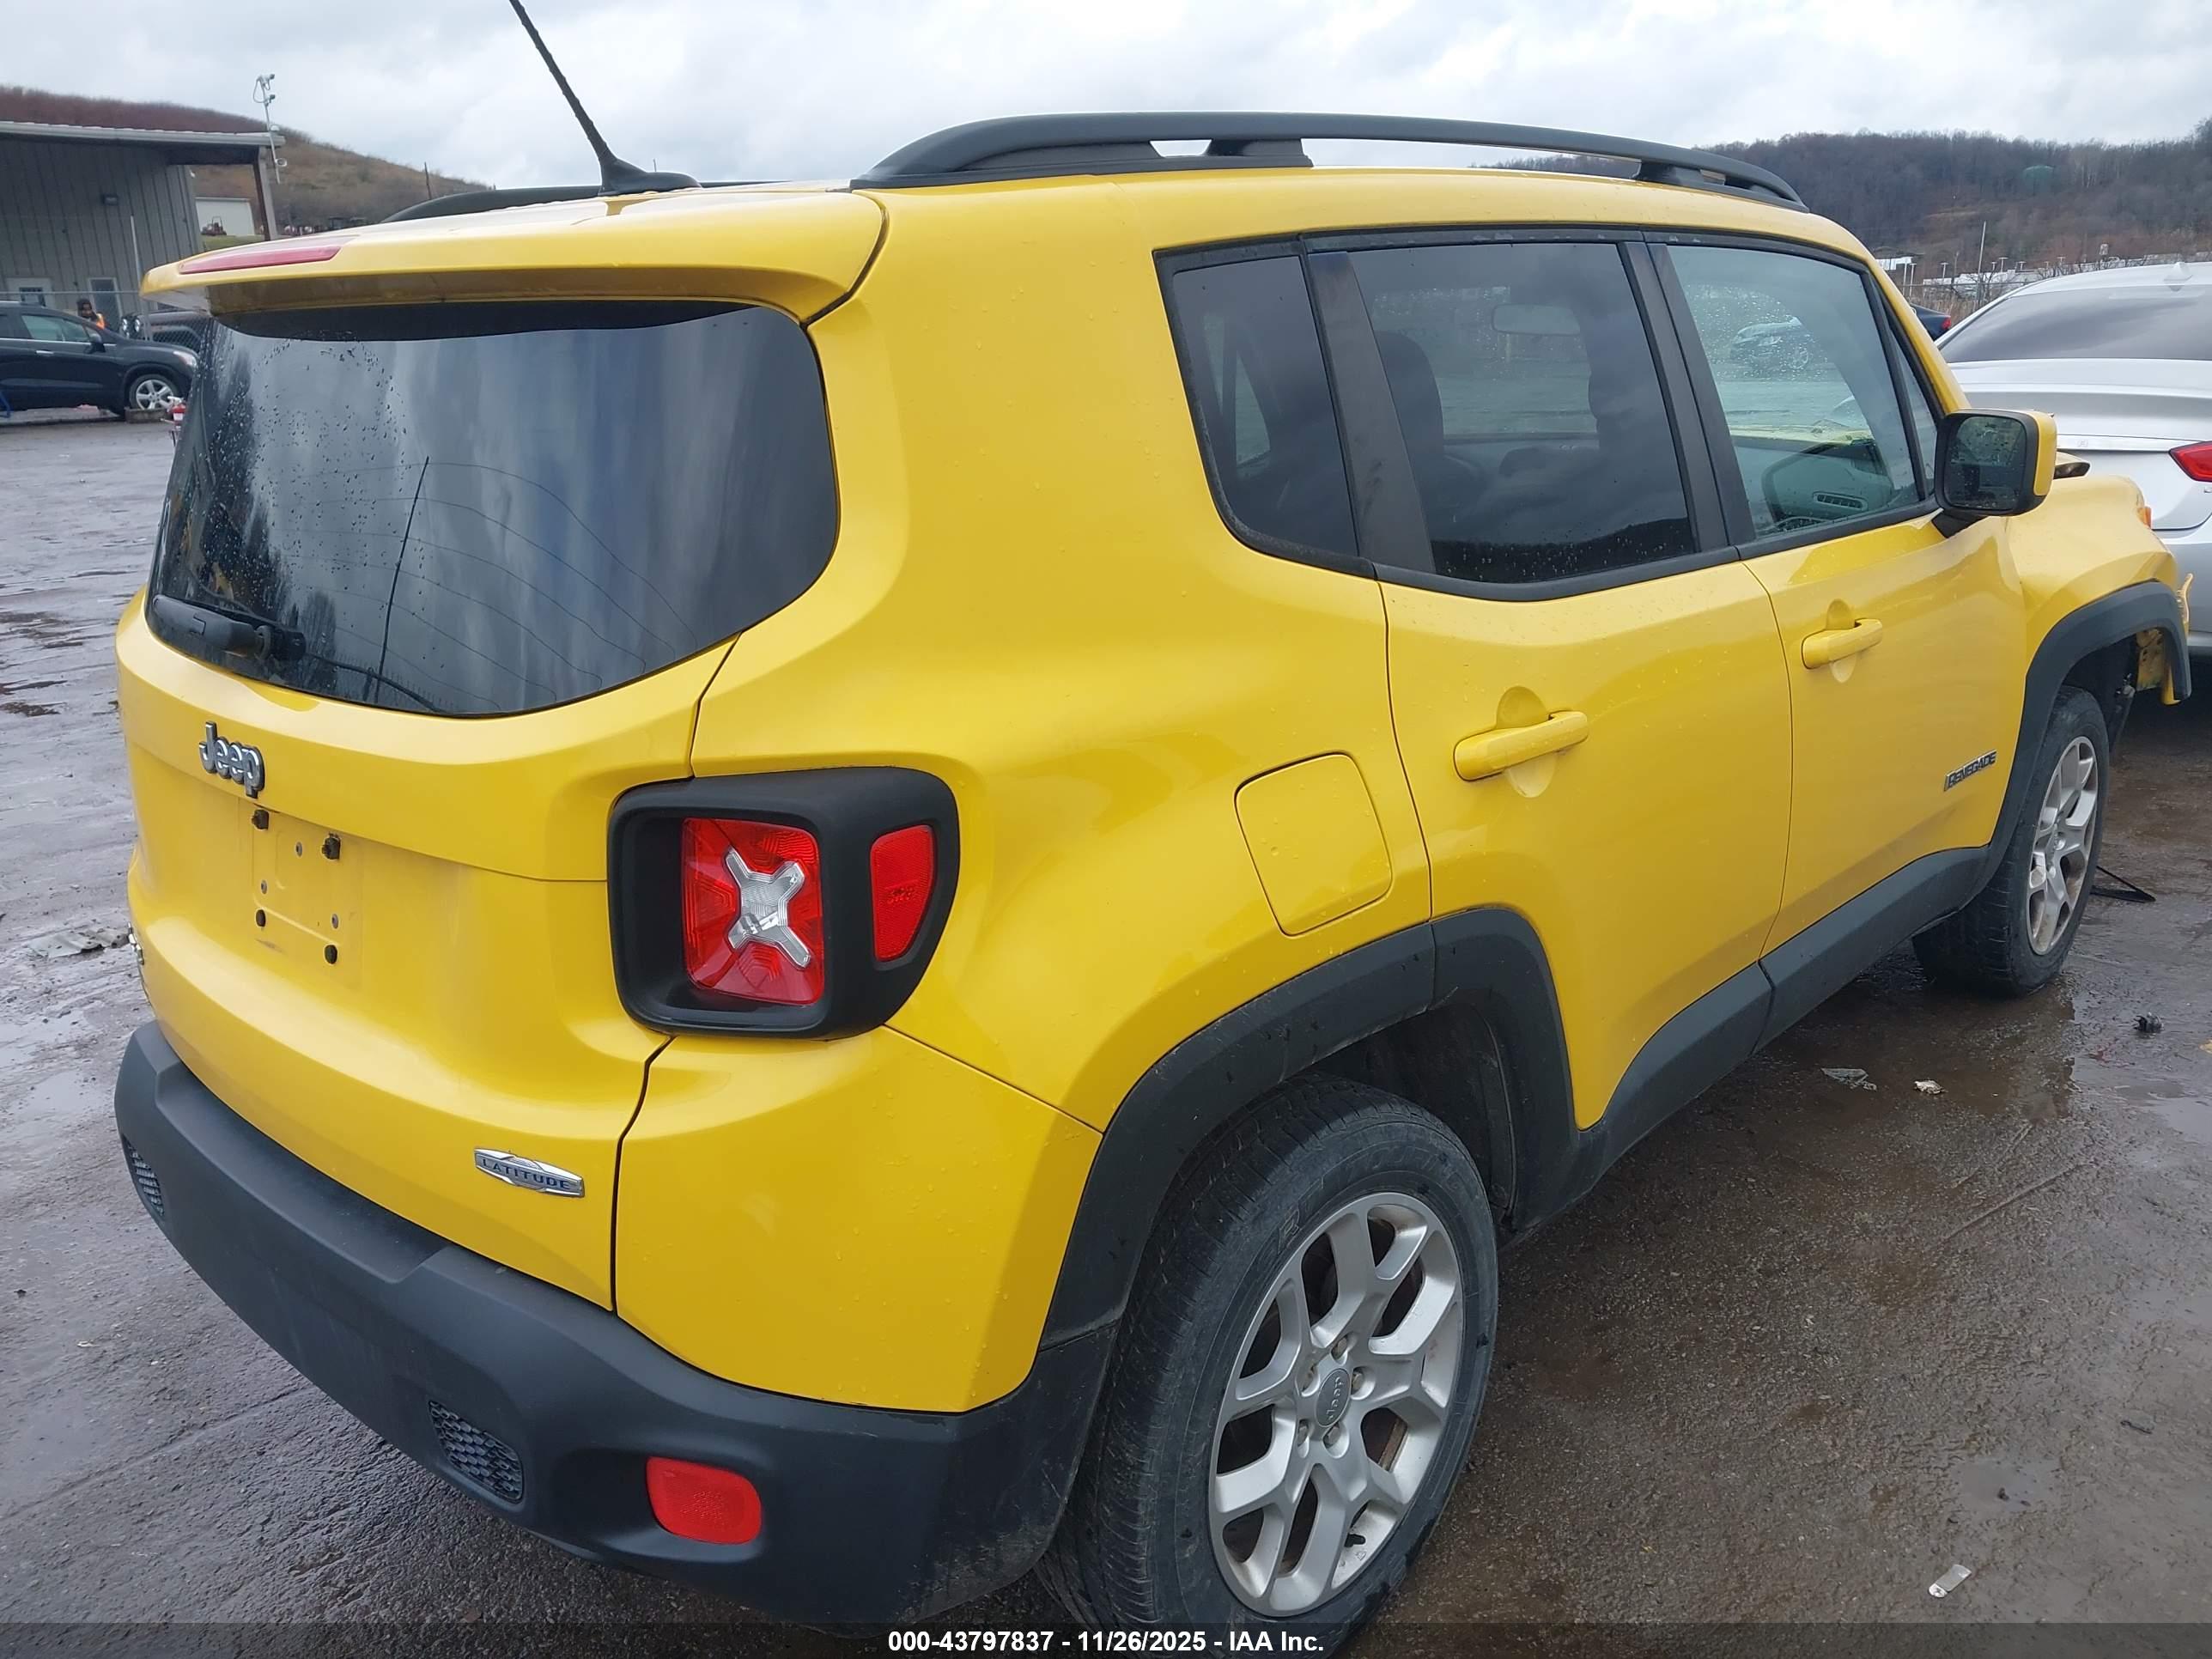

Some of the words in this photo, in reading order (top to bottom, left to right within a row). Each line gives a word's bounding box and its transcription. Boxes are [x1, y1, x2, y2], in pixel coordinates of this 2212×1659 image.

[198, 721, 264, 799] Jeep
[1947, 750, 1996, 789] RENEGADE
[483, 1158, 571, 1190] LATITUDE
